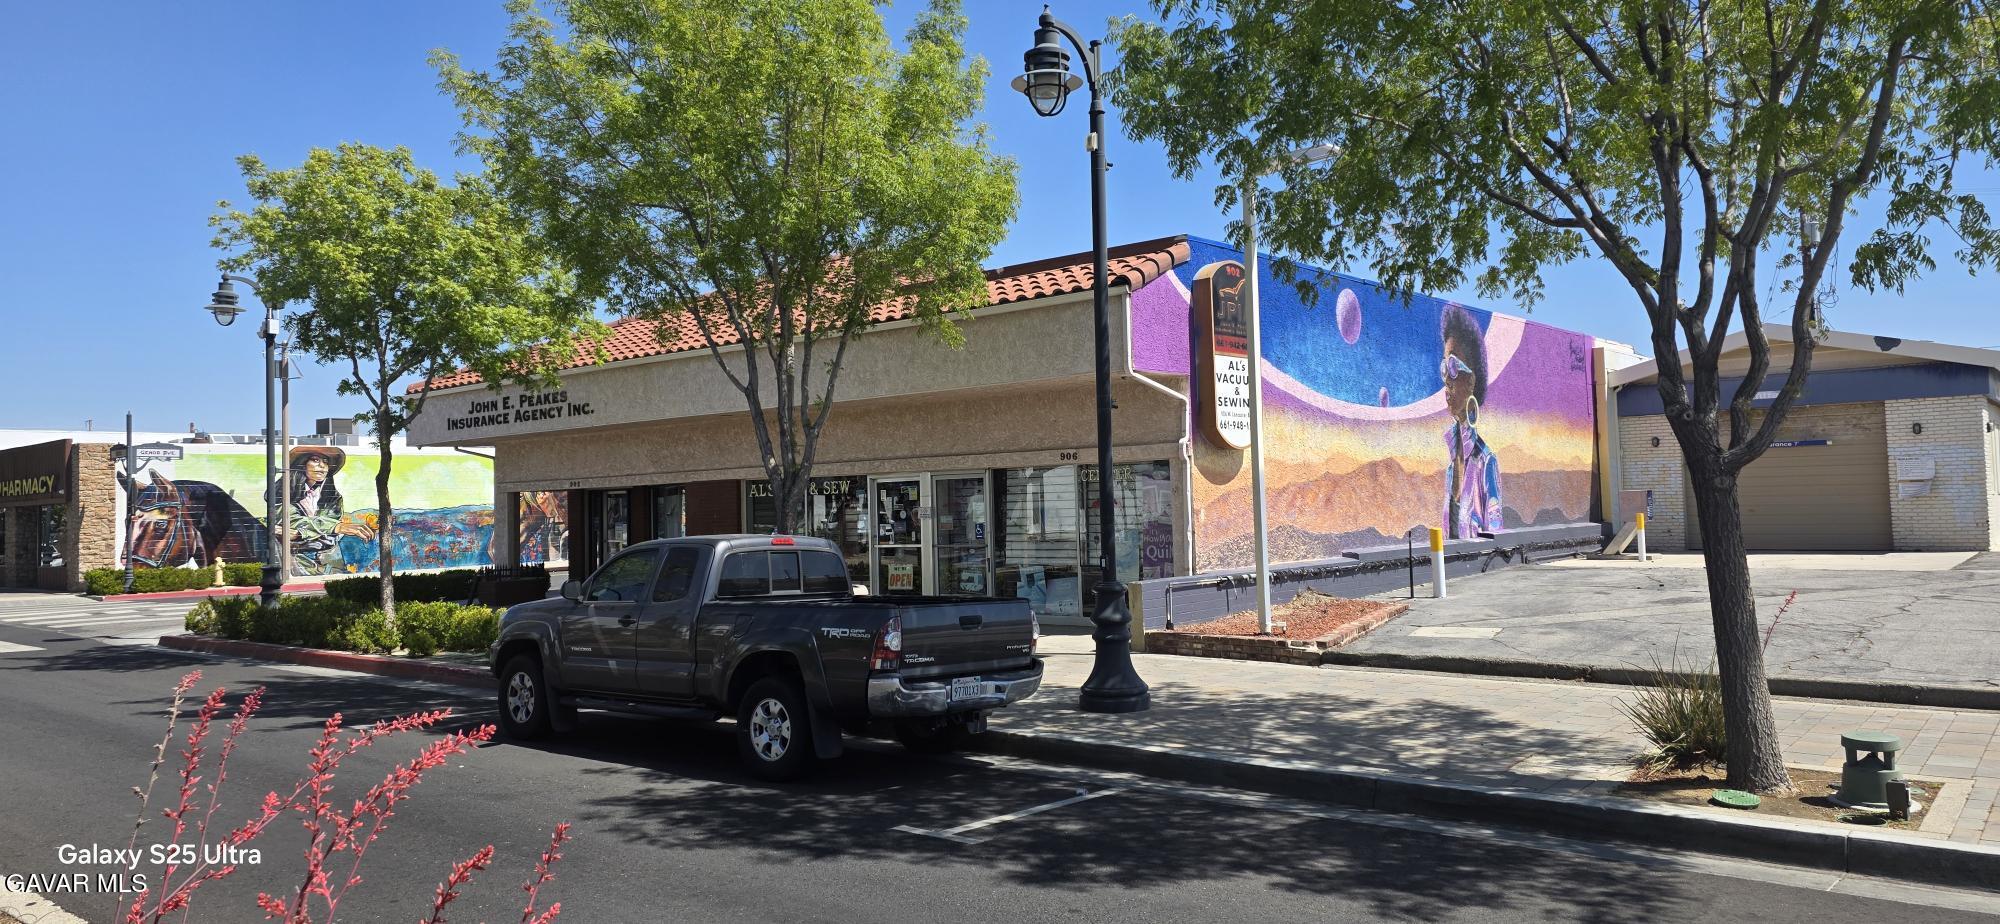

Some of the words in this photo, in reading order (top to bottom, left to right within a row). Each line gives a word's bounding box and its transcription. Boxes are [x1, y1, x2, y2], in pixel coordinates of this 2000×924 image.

[1228, 360, 1246, 372] AL's
[1216, 372, 1249, 386] VACUU
[1234, 386, 1240, 396] &
[502, 396, 515, 410] E.
[1218, 396, 1250, 408] SEWIN
[1220, 420, 1250, 430] 661-948-1
[1060, 452, 1078, 461] 906
[810, 481, 819, 496] &
[823, 480, 851, 495] SEW
[1146, 544, 1172, 561] Quil
[889, 573, 913, 587] OPEN
[821, 627, 850, 639] TRD
